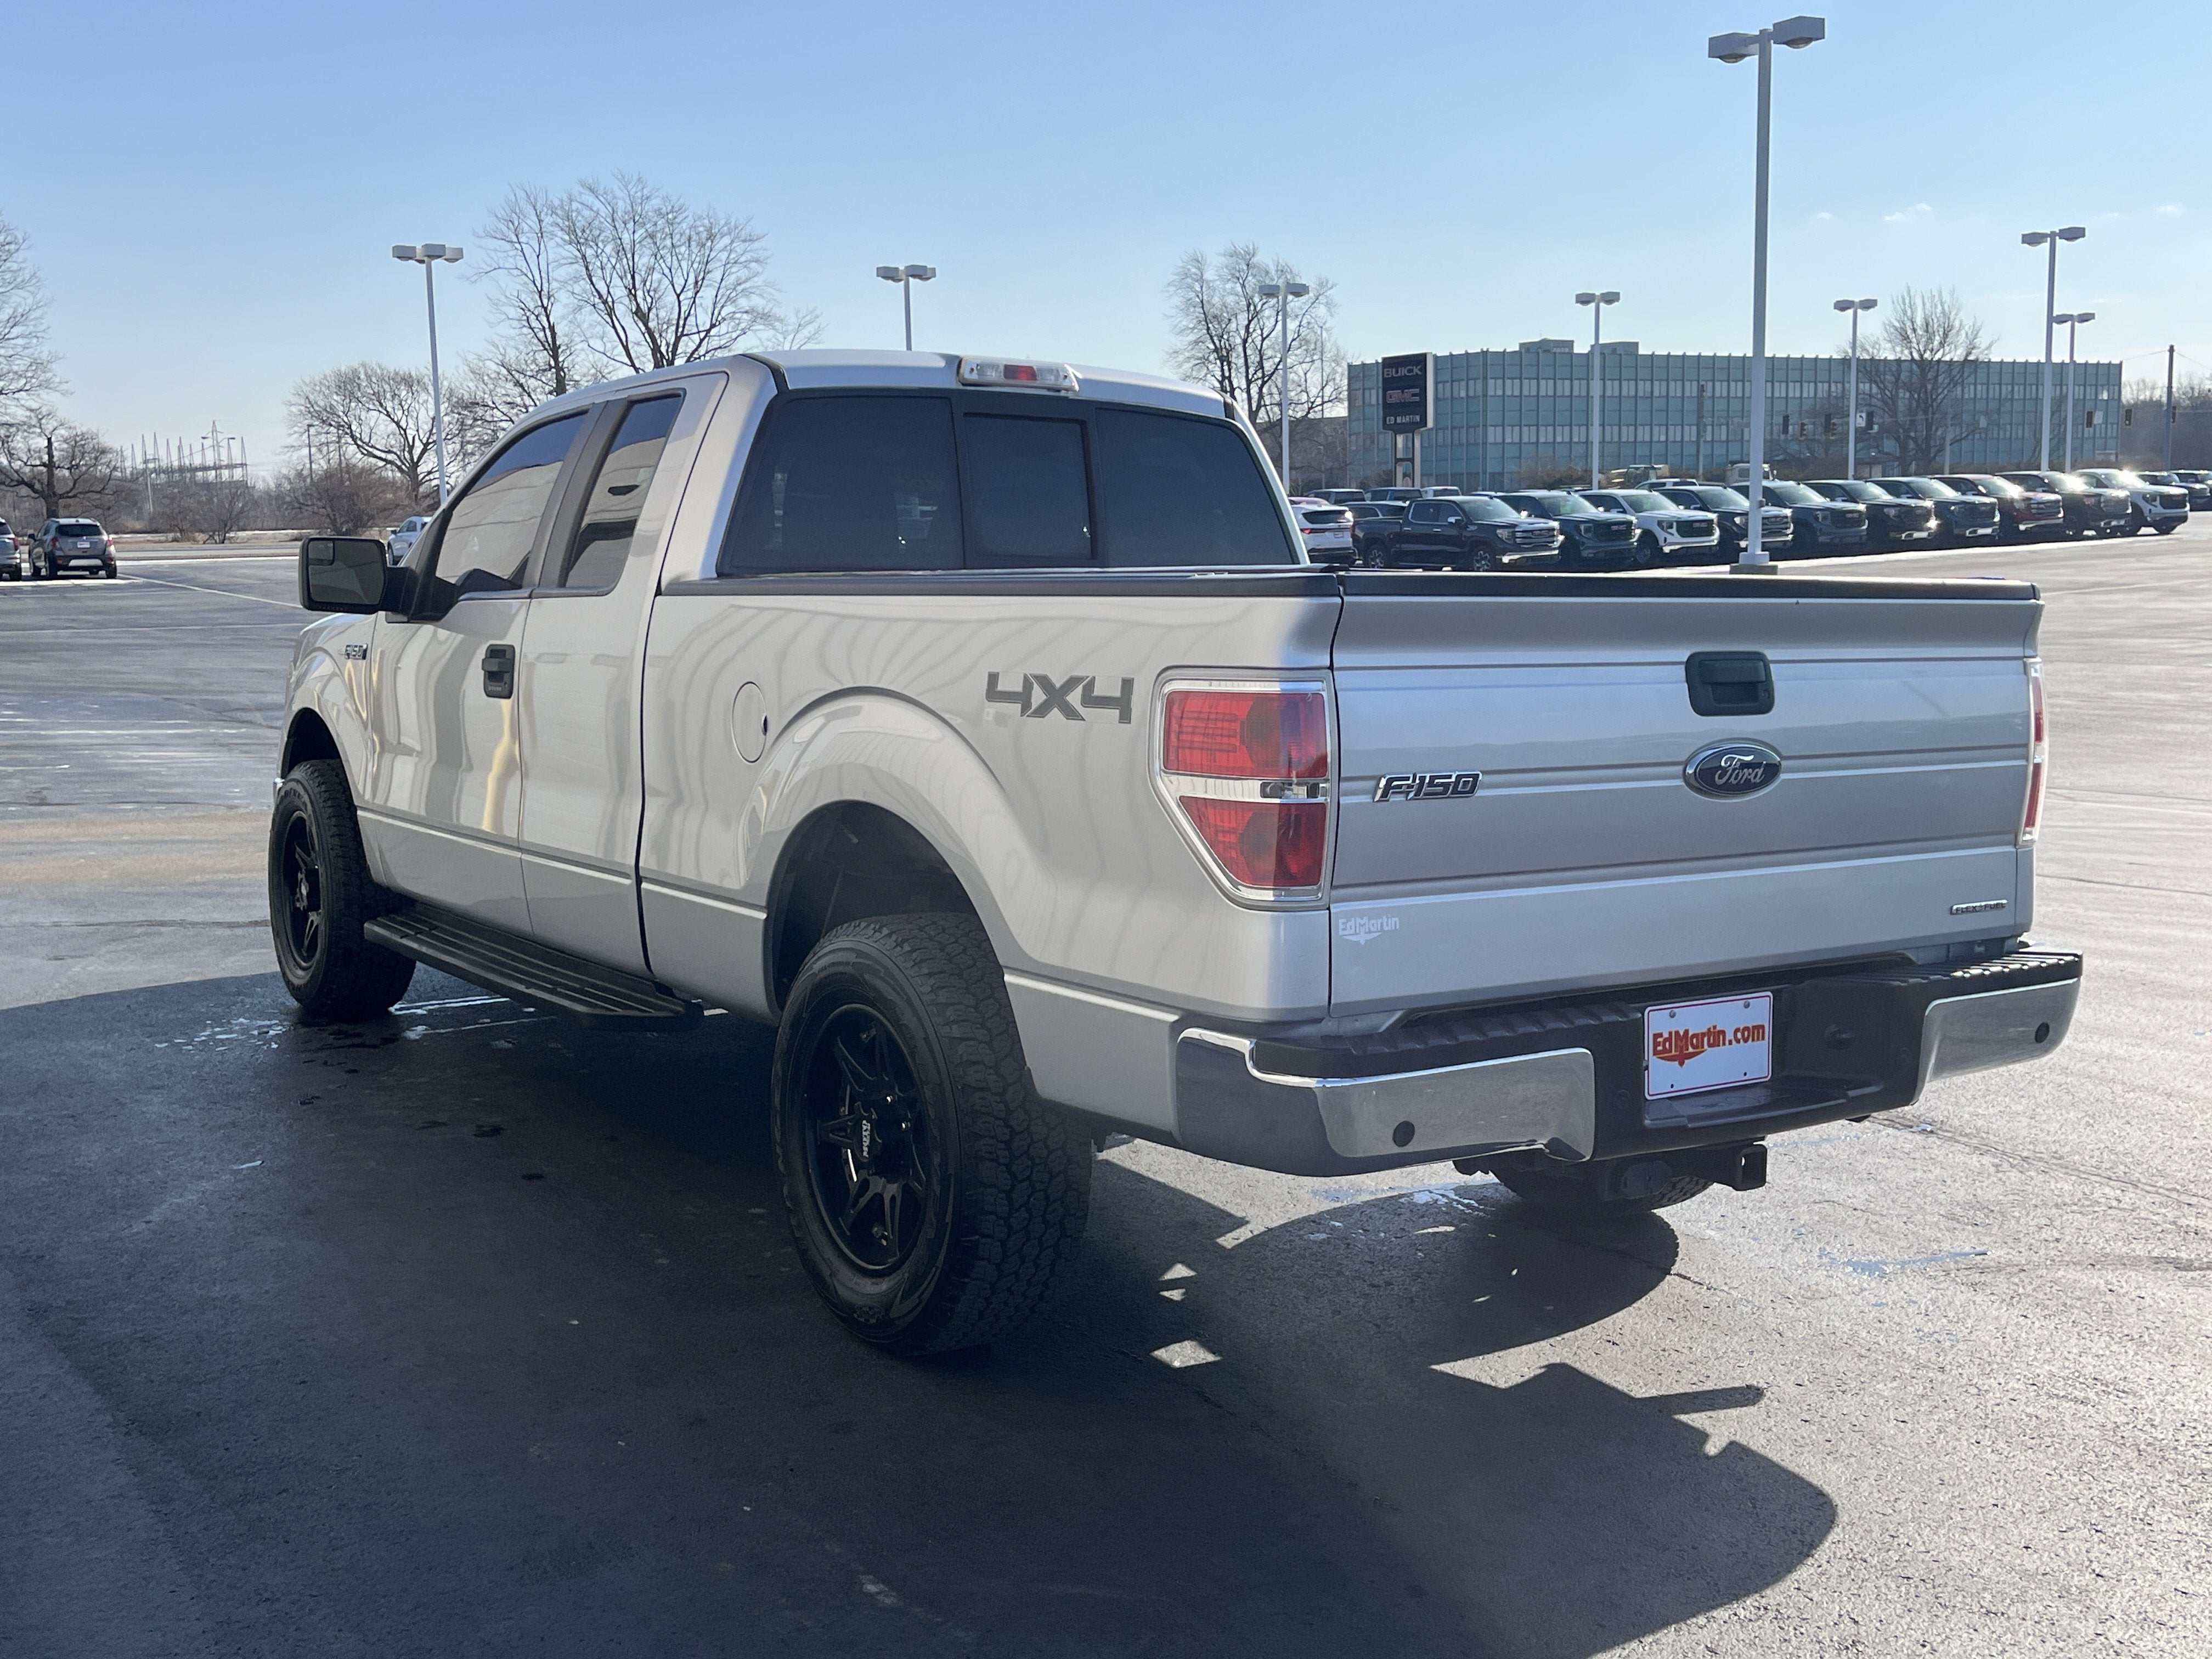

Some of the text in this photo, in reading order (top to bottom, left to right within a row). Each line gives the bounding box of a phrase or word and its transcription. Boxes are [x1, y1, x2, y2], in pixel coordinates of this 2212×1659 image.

[1384, 365, 1422, 378] BUICK
[1386, 388, 1420, 404] GMC
[1386, 415, 1420, 425] ED MARTIN
[1714, 754, 1767, 786] Ford
[1373, 771, 1482, 803] F-150
[1339, 915, 1400, 938] EdMartin
[1652, 1024, 1766, 1060] EdMartin.com
